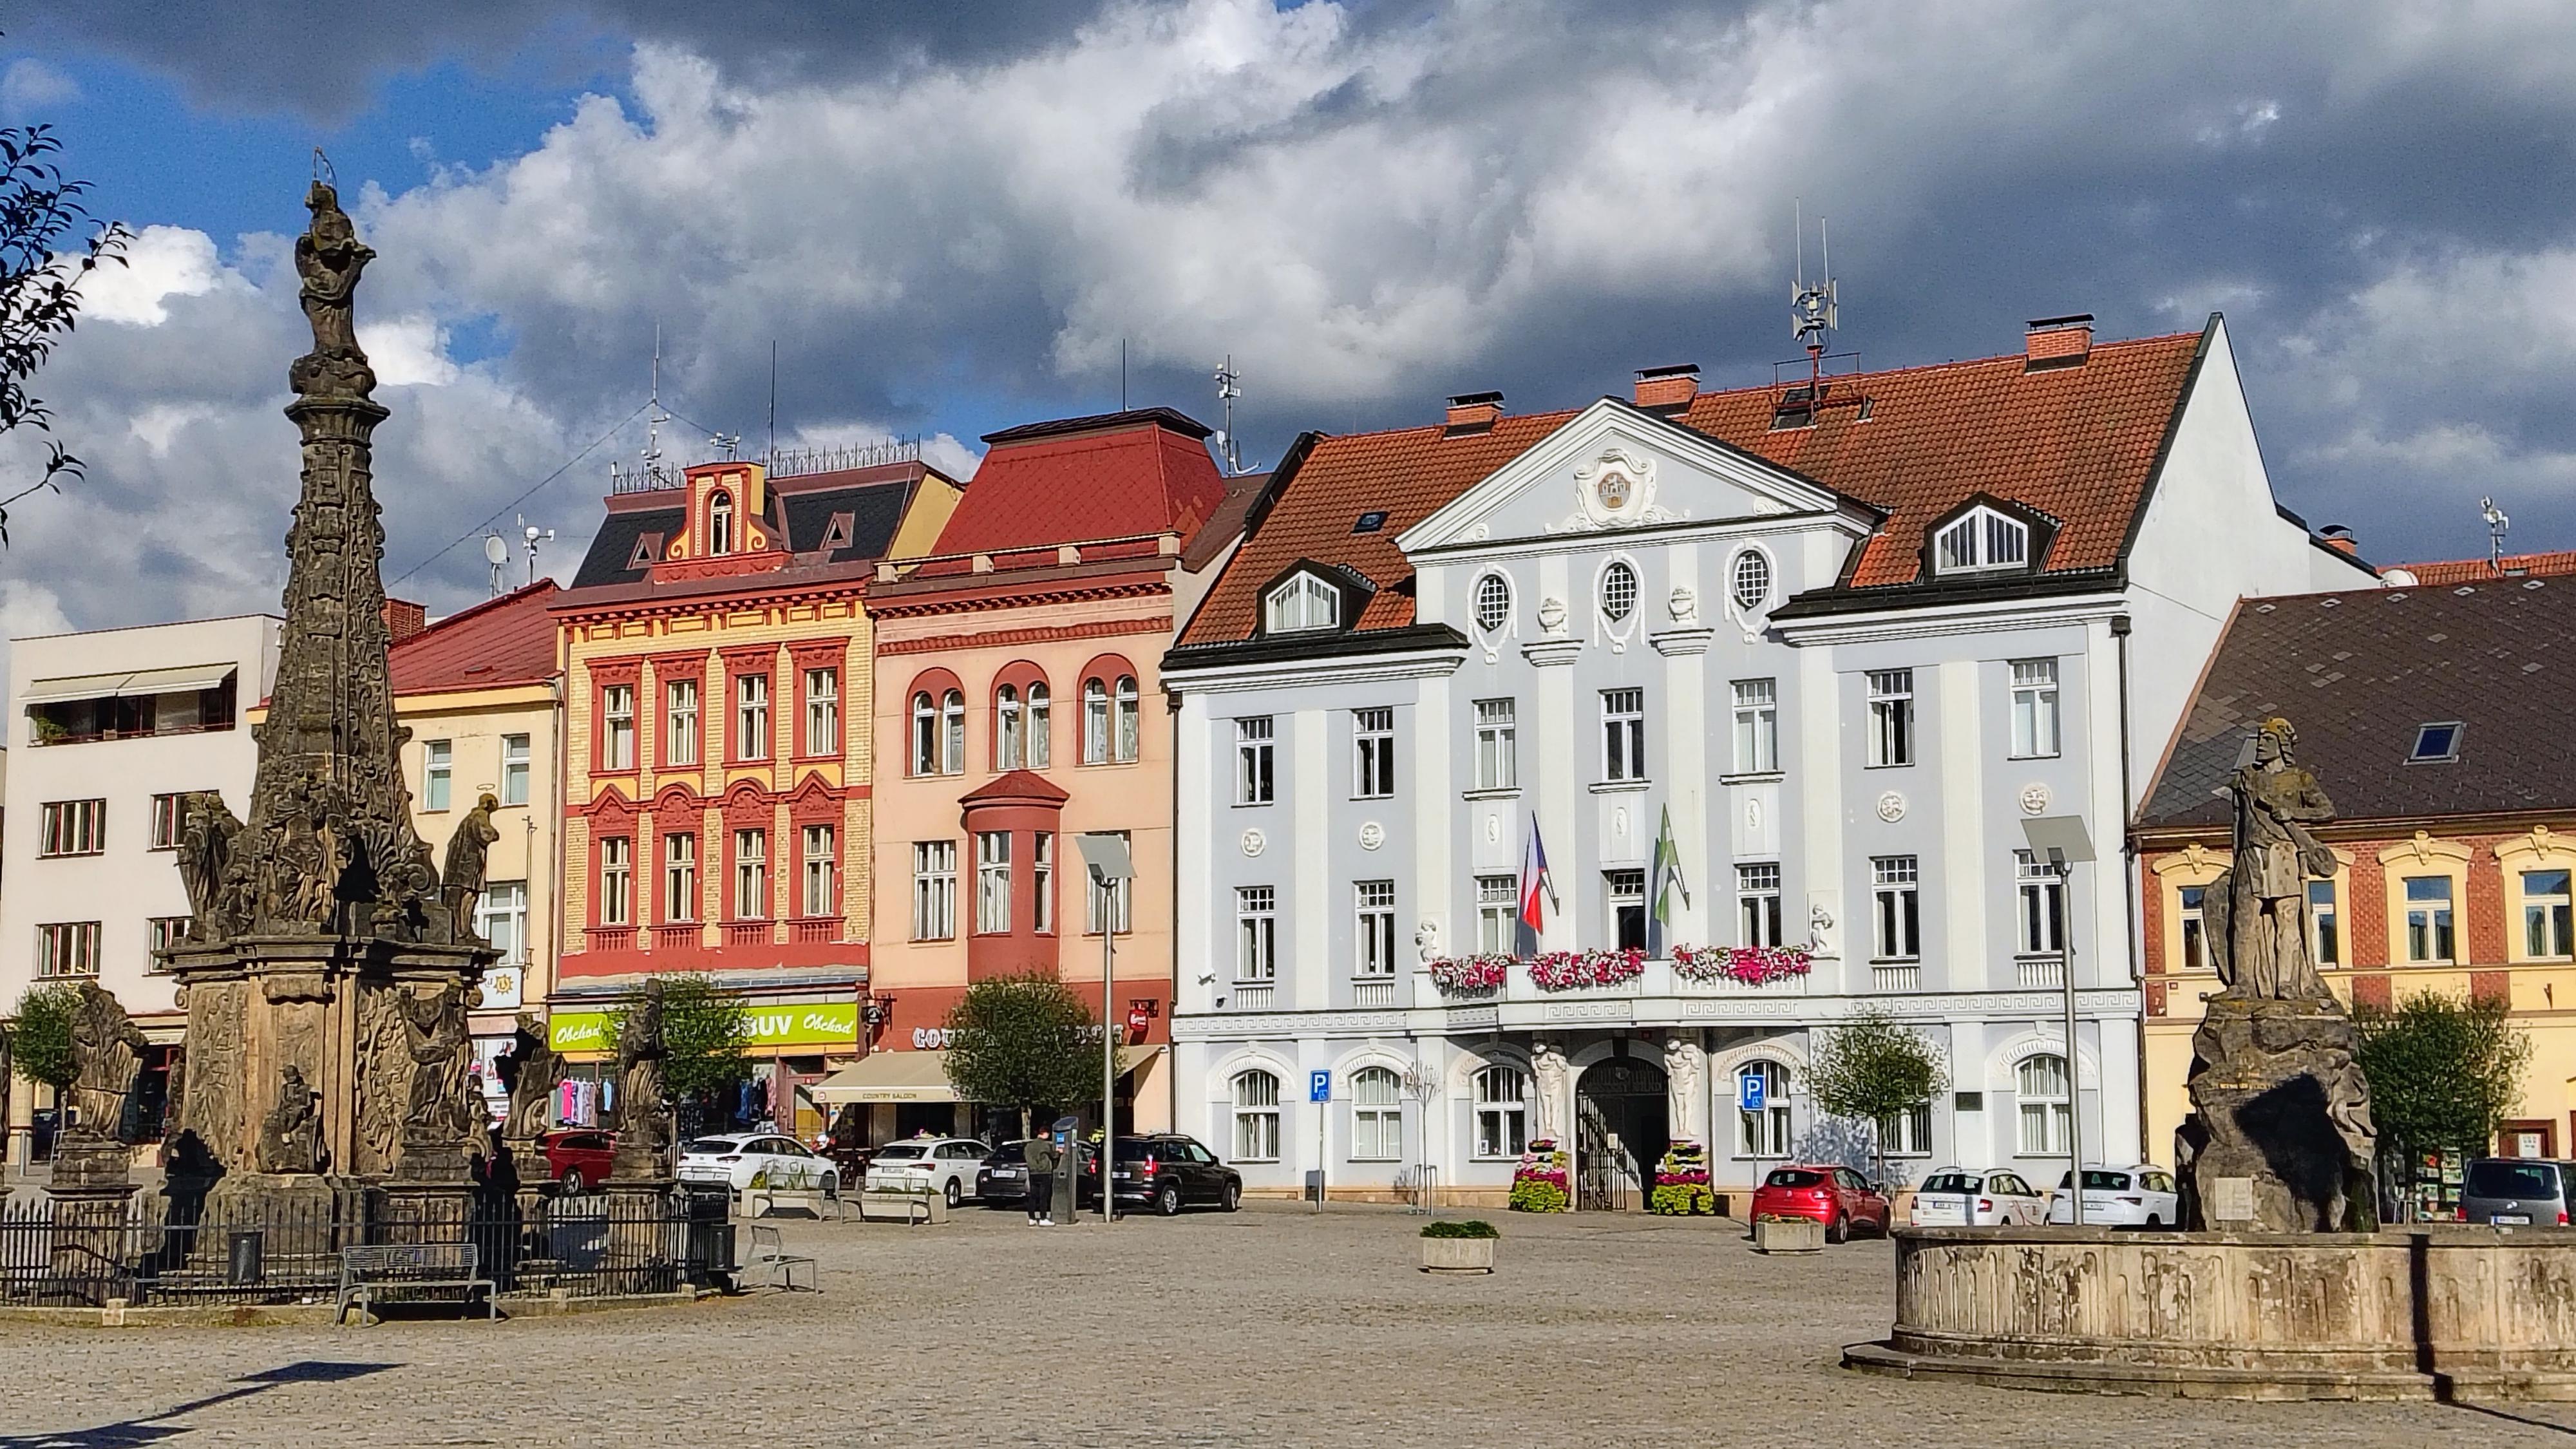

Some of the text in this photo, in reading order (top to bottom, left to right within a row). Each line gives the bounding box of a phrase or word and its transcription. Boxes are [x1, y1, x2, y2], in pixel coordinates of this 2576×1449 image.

[556, 1020, 602, 1044] Obchod
[803, 1013, 854, 1034] Obchod
[1314, 1074, 1326, 1093] P
[1747, 1079, 1760, 1099] P
